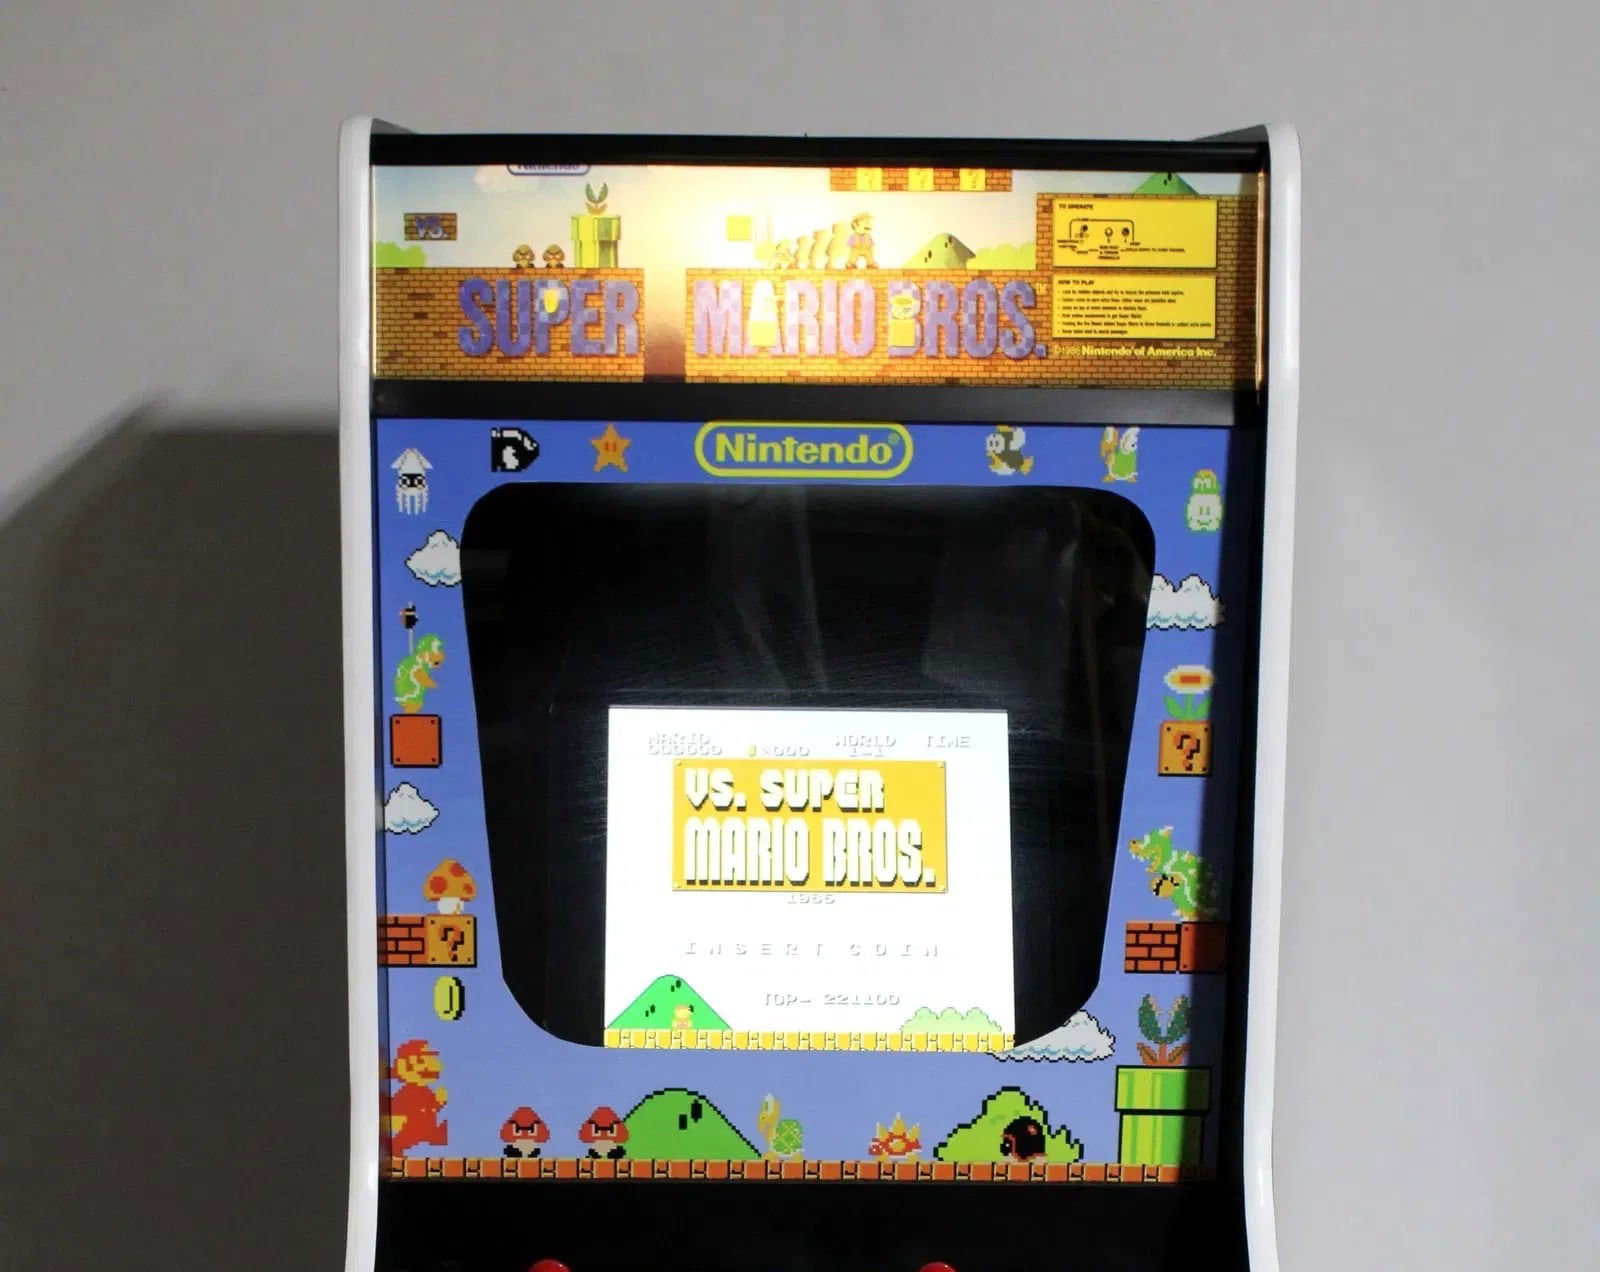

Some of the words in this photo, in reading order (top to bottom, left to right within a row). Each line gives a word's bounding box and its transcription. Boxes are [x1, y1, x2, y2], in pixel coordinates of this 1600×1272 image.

[459, 277, 639, 357] SUPER
[694, 279, 876, 358] MARIO
[888, 278, 1047, 359] BROS.
[1082, 345, 1131, 357] Nintendo
[1147, 346, 1194, 358] America
[835, 735, 897, 747] WORLD
[927, 735, 973, 748] TIME
[684, 767, 747, 811] VS.
[760, 768, 885, 813] SUPER
[684, 816, 809, 886] MARIO
[822, 817, 936, 887] BROS.
